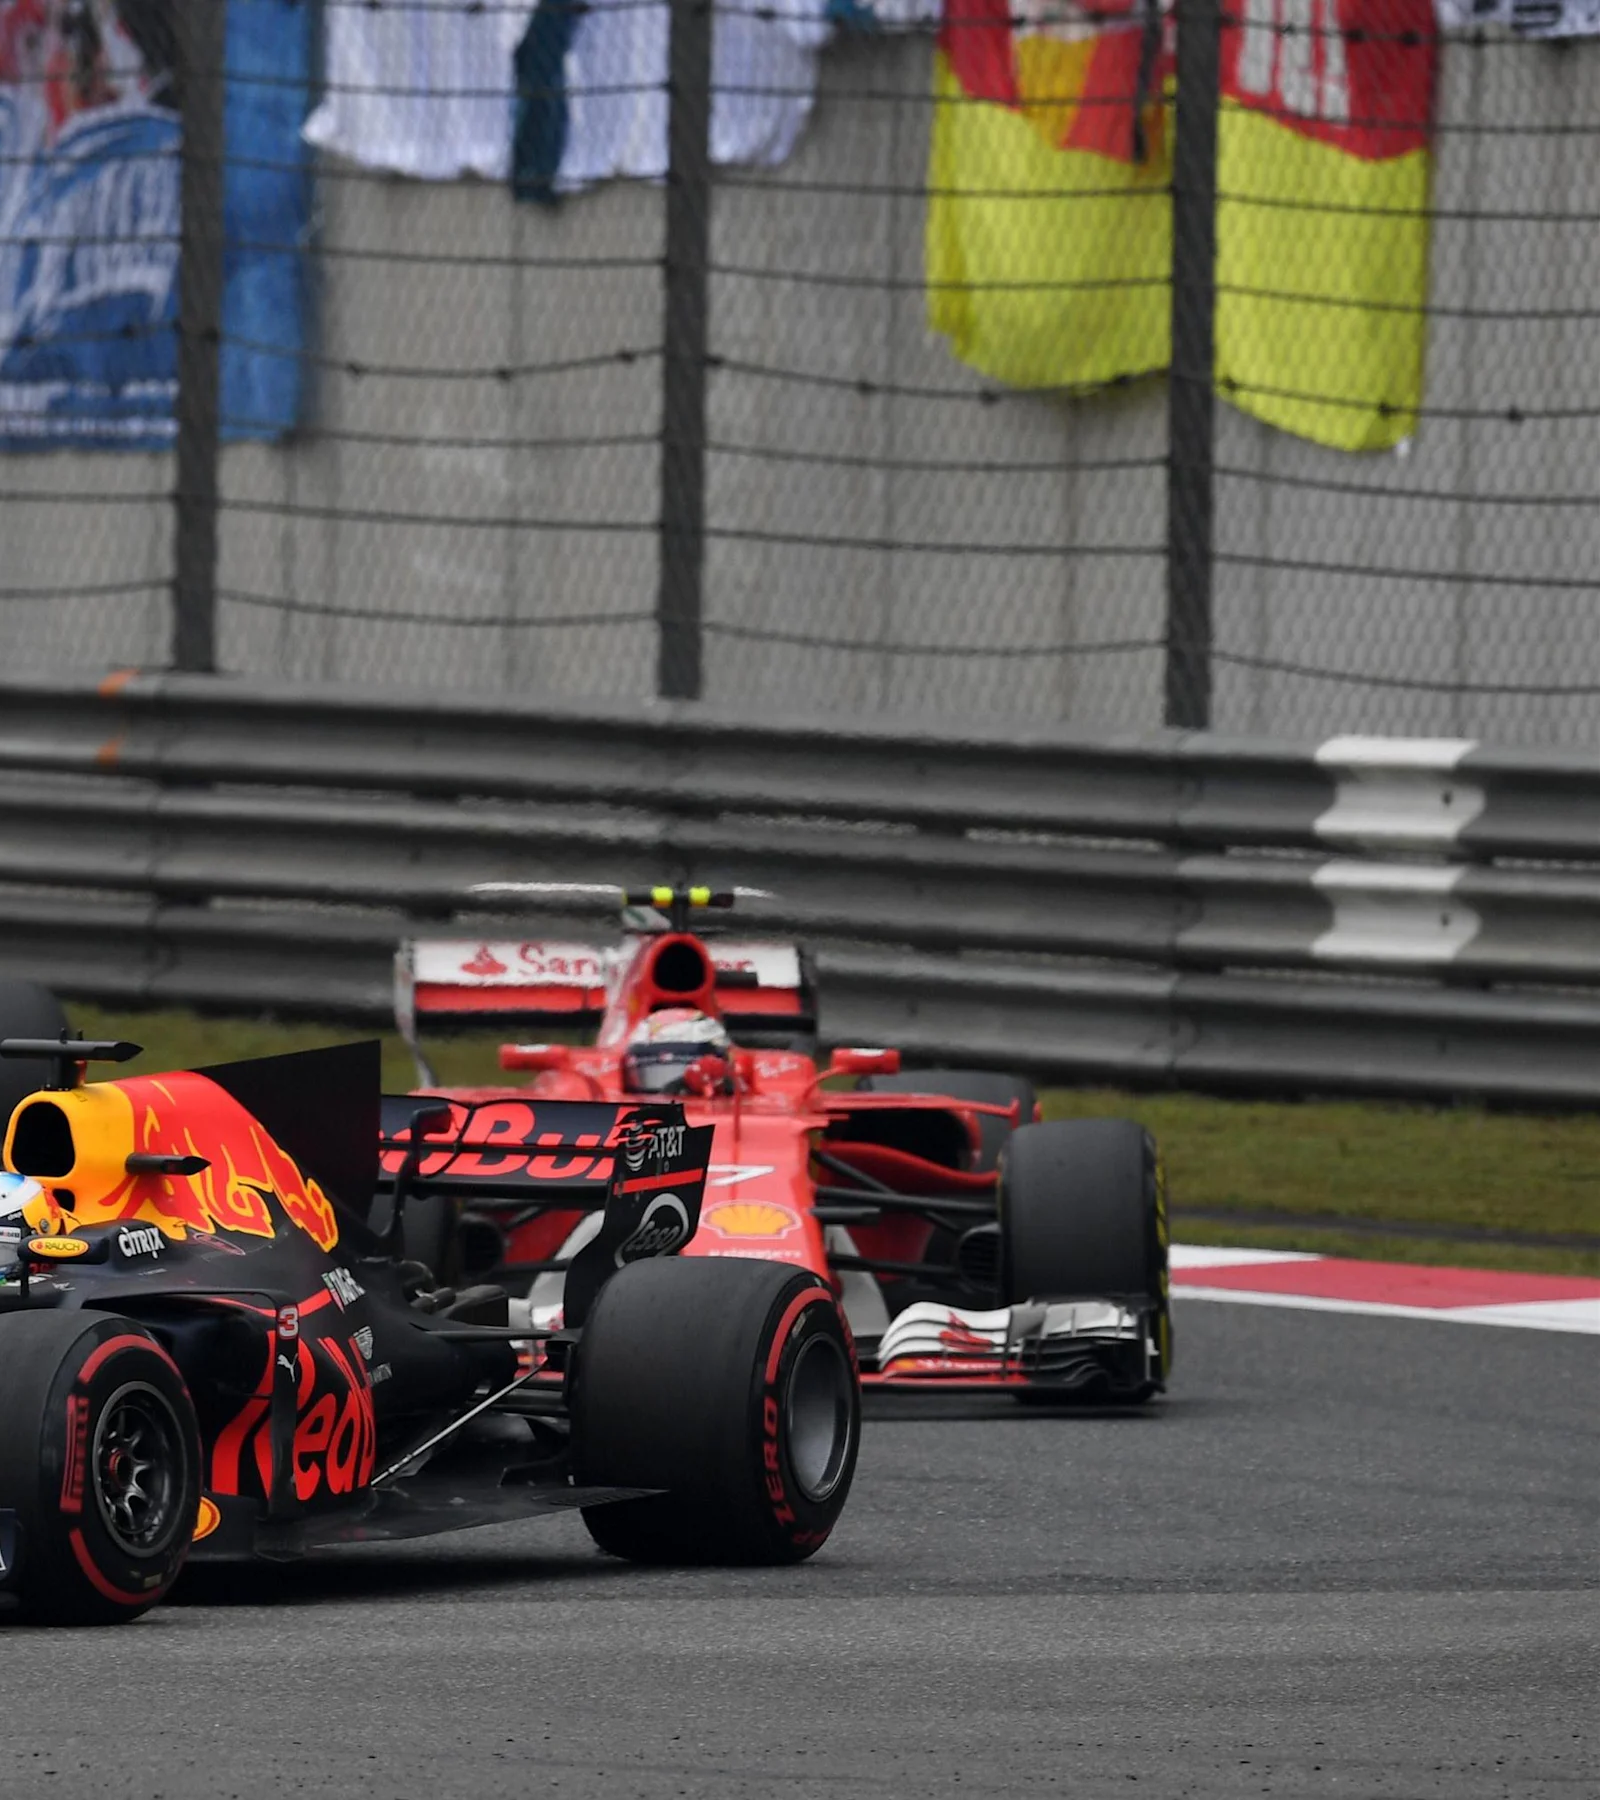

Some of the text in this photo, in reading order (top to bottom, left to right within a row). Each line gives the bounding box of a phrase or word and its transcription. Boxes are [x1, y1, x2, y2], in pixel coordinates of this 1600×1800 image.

[648, 1126, 686, 1159] AT&T
[45, 1242, 80, 1251] RAUCH
[279, 1306, 299, 1338] 3
[763, 1396, 796, 1528] ZERO
